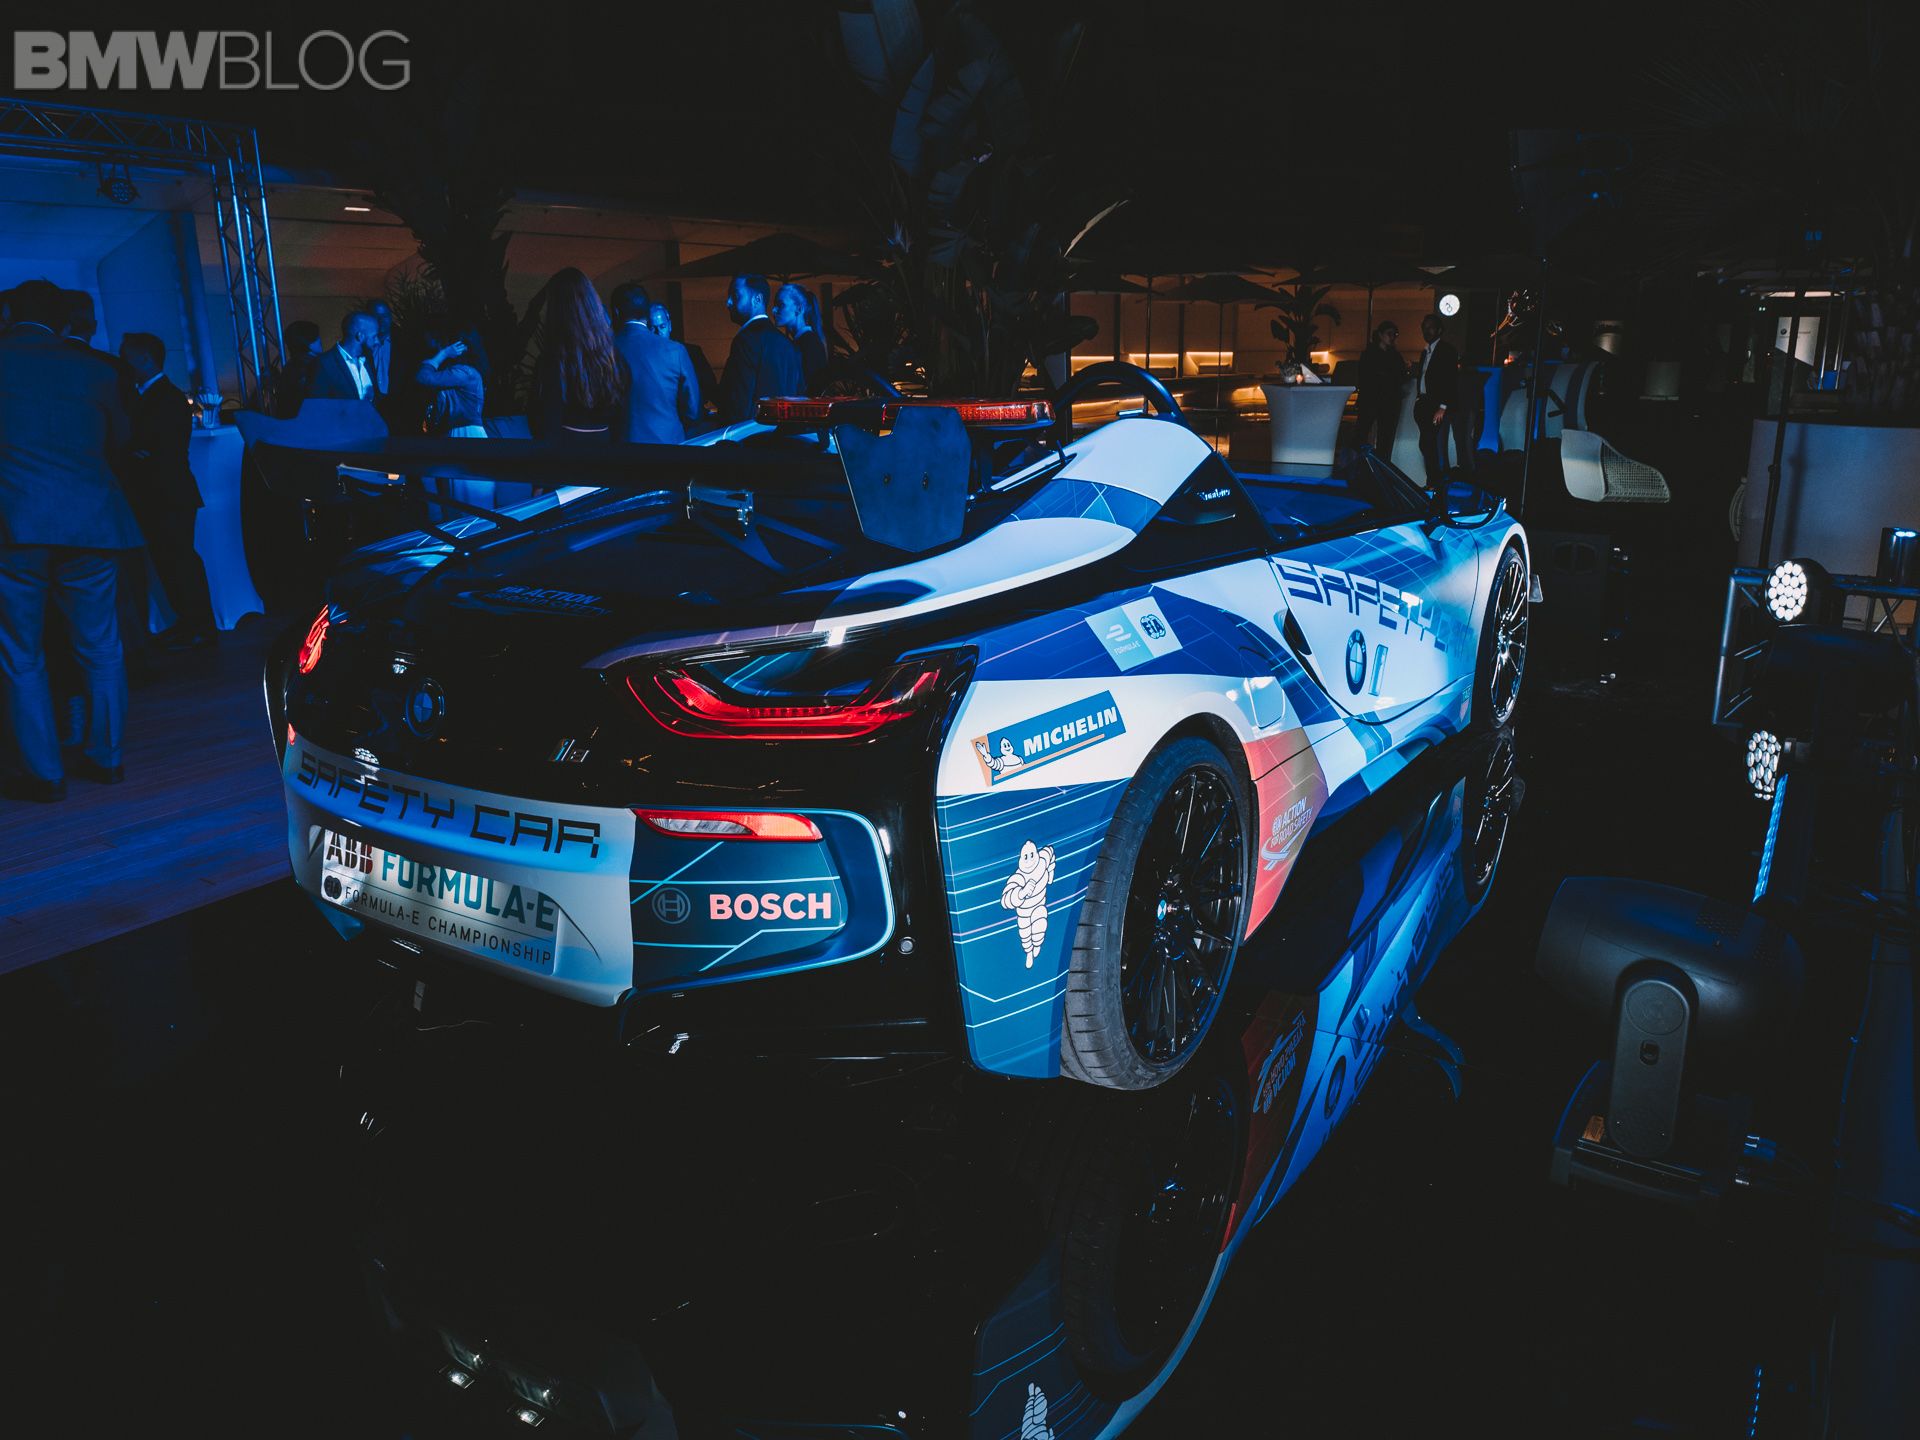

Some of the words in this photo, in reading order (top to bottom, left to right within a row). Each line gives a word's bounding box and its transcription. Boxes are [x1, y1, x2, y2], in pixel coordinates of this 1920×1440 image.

[1141, 618, 1164, 636] FIA
[1267, 556, 1435, 642] SAFETY
[1022, 705, 1118, 757] MICHELIN
[296, 751, 456, 829] SAFETY
[469, 804, 601, 859] CAR
[326, 832, 373, 875] ABB
[382, 850, 555, 932] FORMULA-E
[709, 892, 832, 920] BOSCH
[344, 886, 421, 926] FORMULA-E
[427, 915, 552, 967] CHAMPIONSHIP
